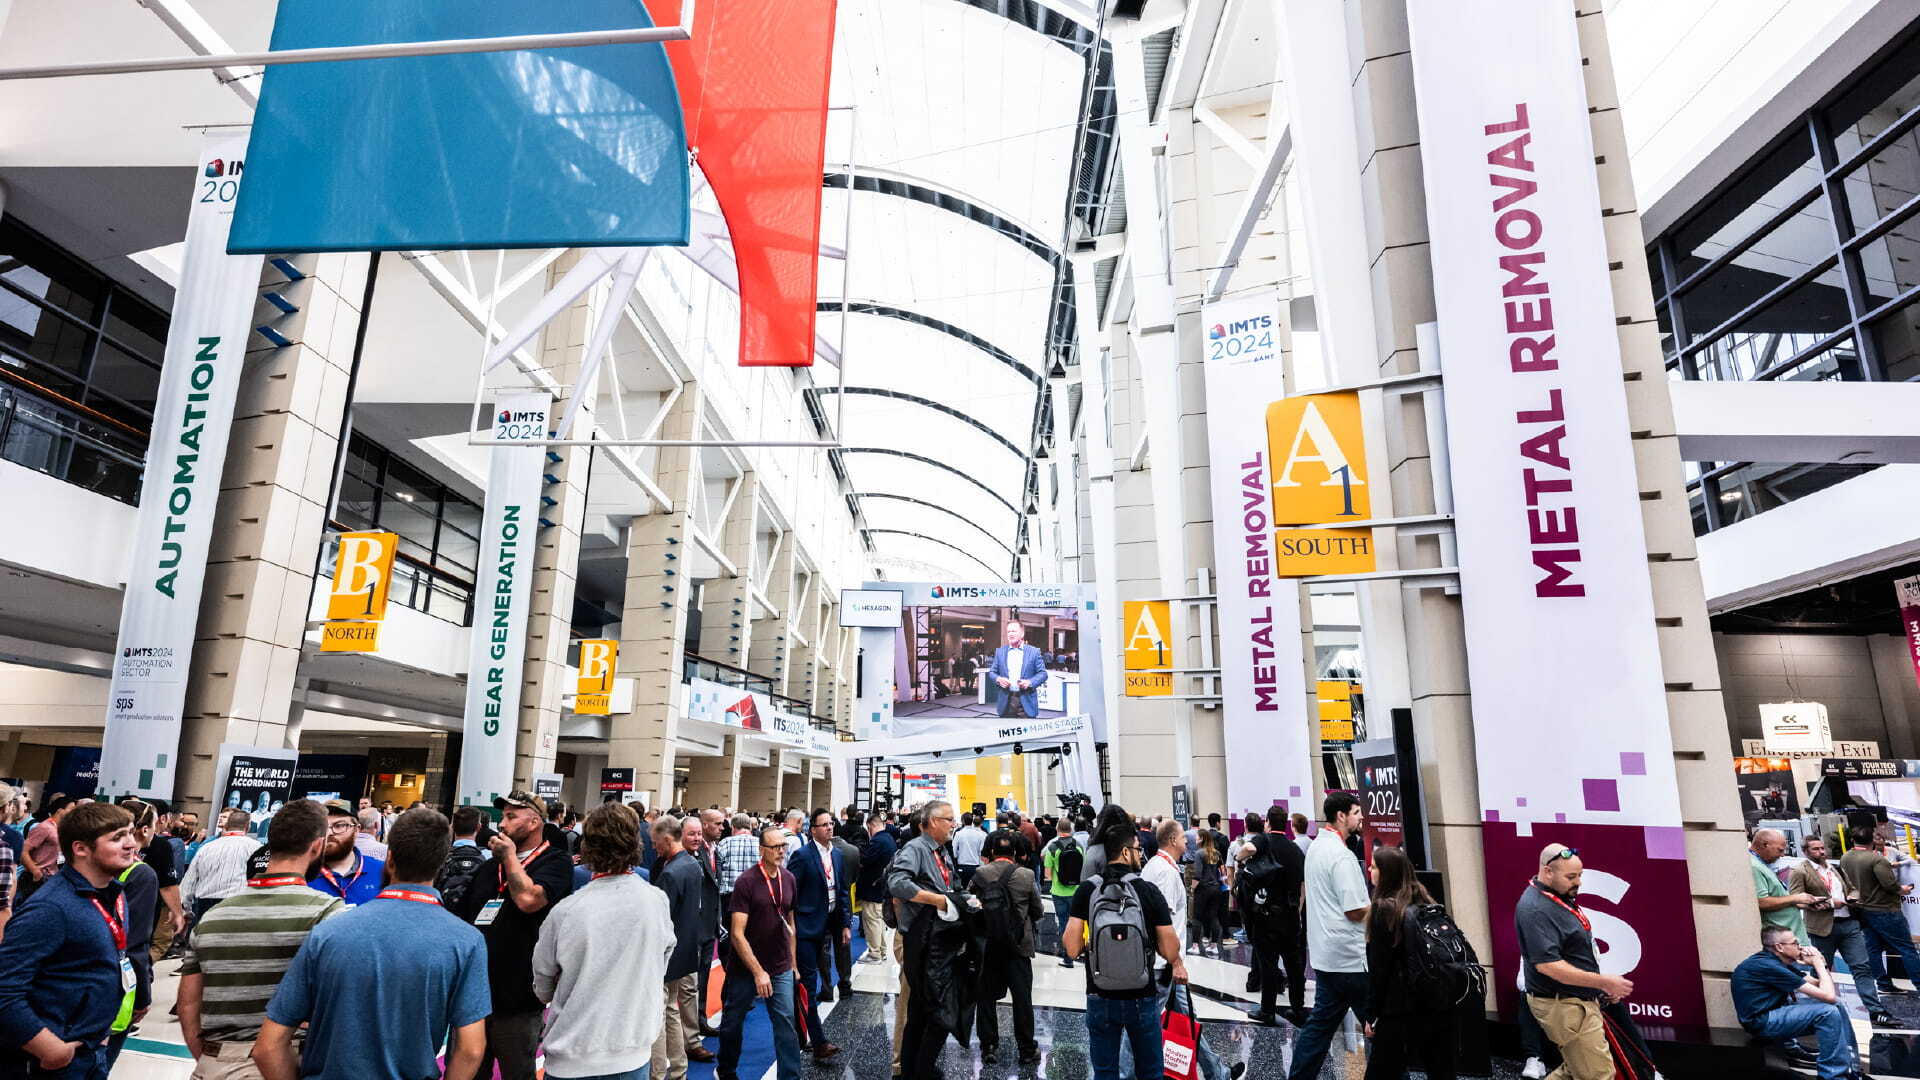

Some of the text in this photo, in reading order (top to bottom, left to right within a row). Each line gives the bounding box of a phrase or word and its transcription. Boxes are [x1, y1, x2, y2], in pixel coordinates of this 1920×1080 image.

[228, 160, 244, 176] IM
[200, 180, 238, 203] 20
[1229, 315, 1272, 335] IMTS
[1211, 331, 1274, 361] 2024
[1484, 102, 1585, 598] METAL REMOVAL
[513, 411, 545, 422] IMTS
[497, 424, 544, 440] 2024
[155, 336, 221, 600] AUTOMATION
[1282, 537, 1369, 556] SOUTH
[1241, 451, 1279, 712] METAL REMOVAL
[988, 588, 1019, 598] MAIN
[1023, 588, 1062, 599] STAGE
[484, 505, 521, 737] GEAR GENERATION
[325, 627, 376, 640] NORTH
[122, 660, 173, 668] AUTOMATION
[121, 668, 151, 677] SECTOR
[1128, 676, 1170, 687] SOUTH
[116, 698, 134, 713] sps
[1055, 716, 1083, 729] STAGE
[1841, 743, 1872, 757] Exit
[235, 767, 253, 778] THE
[231, 778, 276, 788] ACCORDING
[1629, 1002, 1673, 1018] DING
